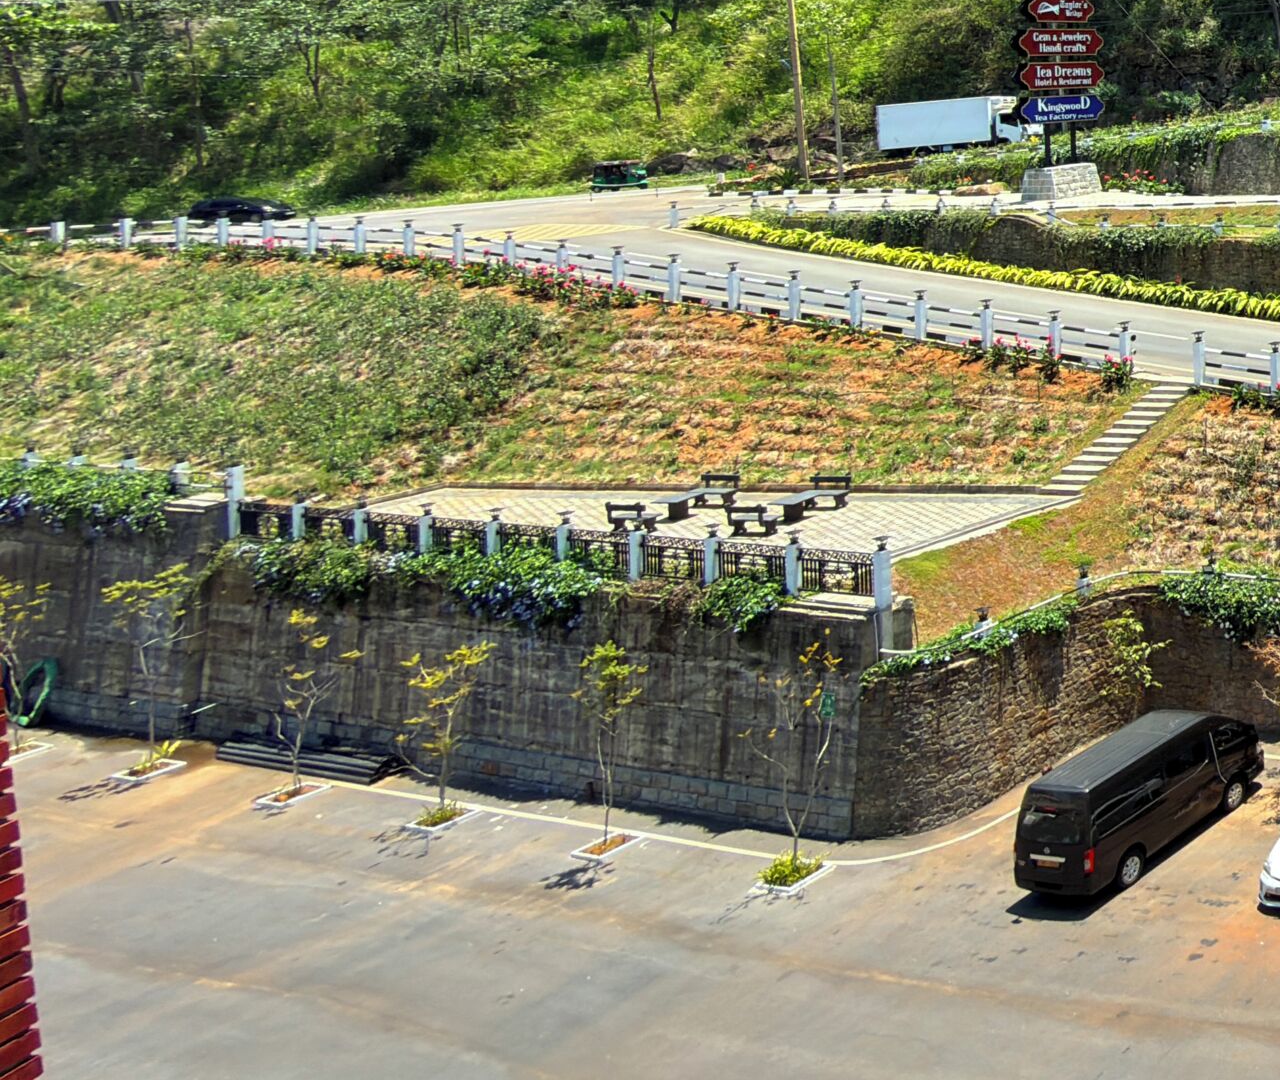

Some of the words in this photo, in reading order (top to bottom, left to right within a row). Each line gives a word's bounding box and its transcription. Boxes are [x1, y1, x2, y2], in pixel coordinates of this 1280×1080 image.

[1033, 32, 1051, 41] Gem
[1063, 43, 1087, 52] crafts
[1035, 66, 1052, 78] Tea
[1054, 65, 1092, 77] Dreams
[1035, 79, 1052, 87] Hotel
[1058, 77, 1092, 85] Restaurant
[1049, 113, 1077, 121] Factory
